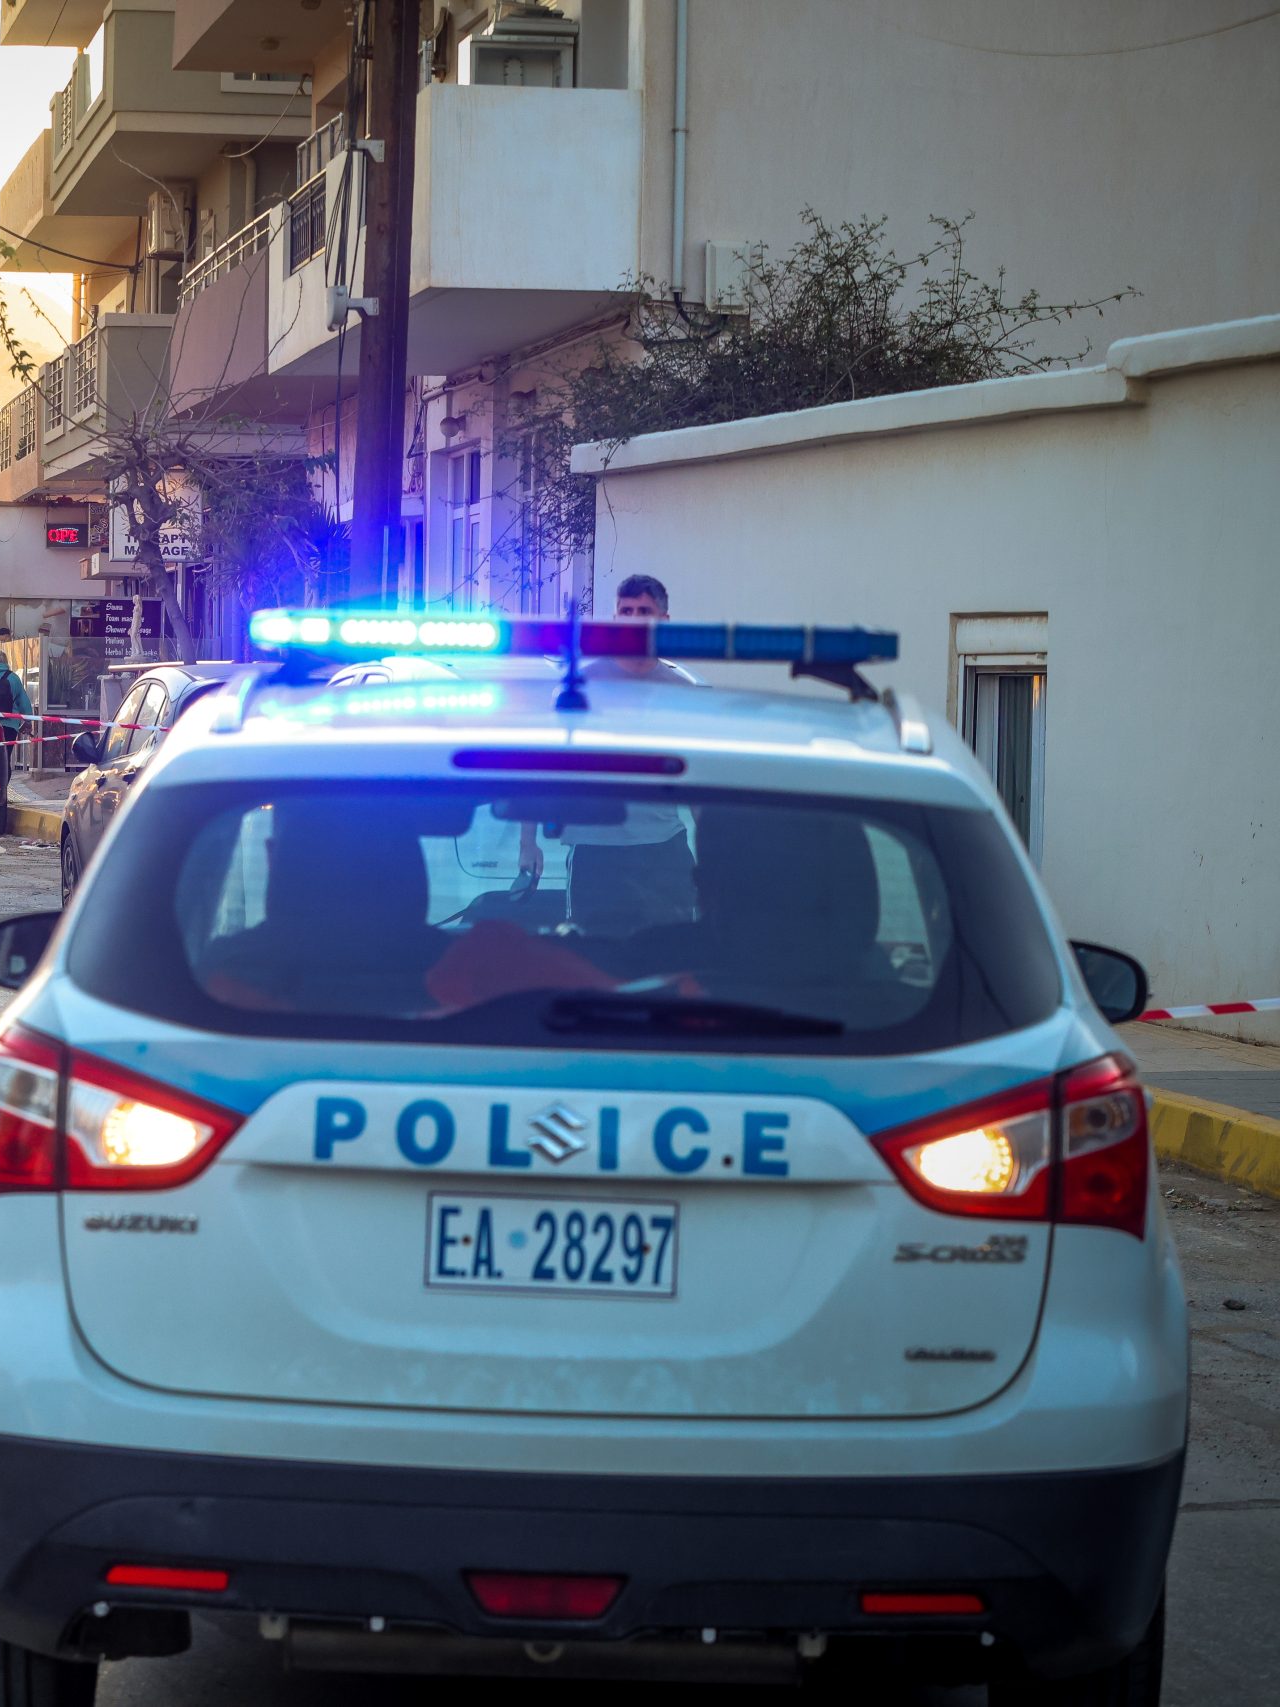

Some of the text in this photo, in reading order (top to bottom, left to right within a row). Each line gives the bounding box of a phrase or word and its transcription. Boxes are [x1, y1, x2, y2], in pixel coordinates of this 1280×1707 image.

[125, 534, 186, 543] TAPY
[125, 546, 189, 555] MAGE
[314, 1096, 790, 1177] POLICE
[531, 1209, 676, 1286] 28297
